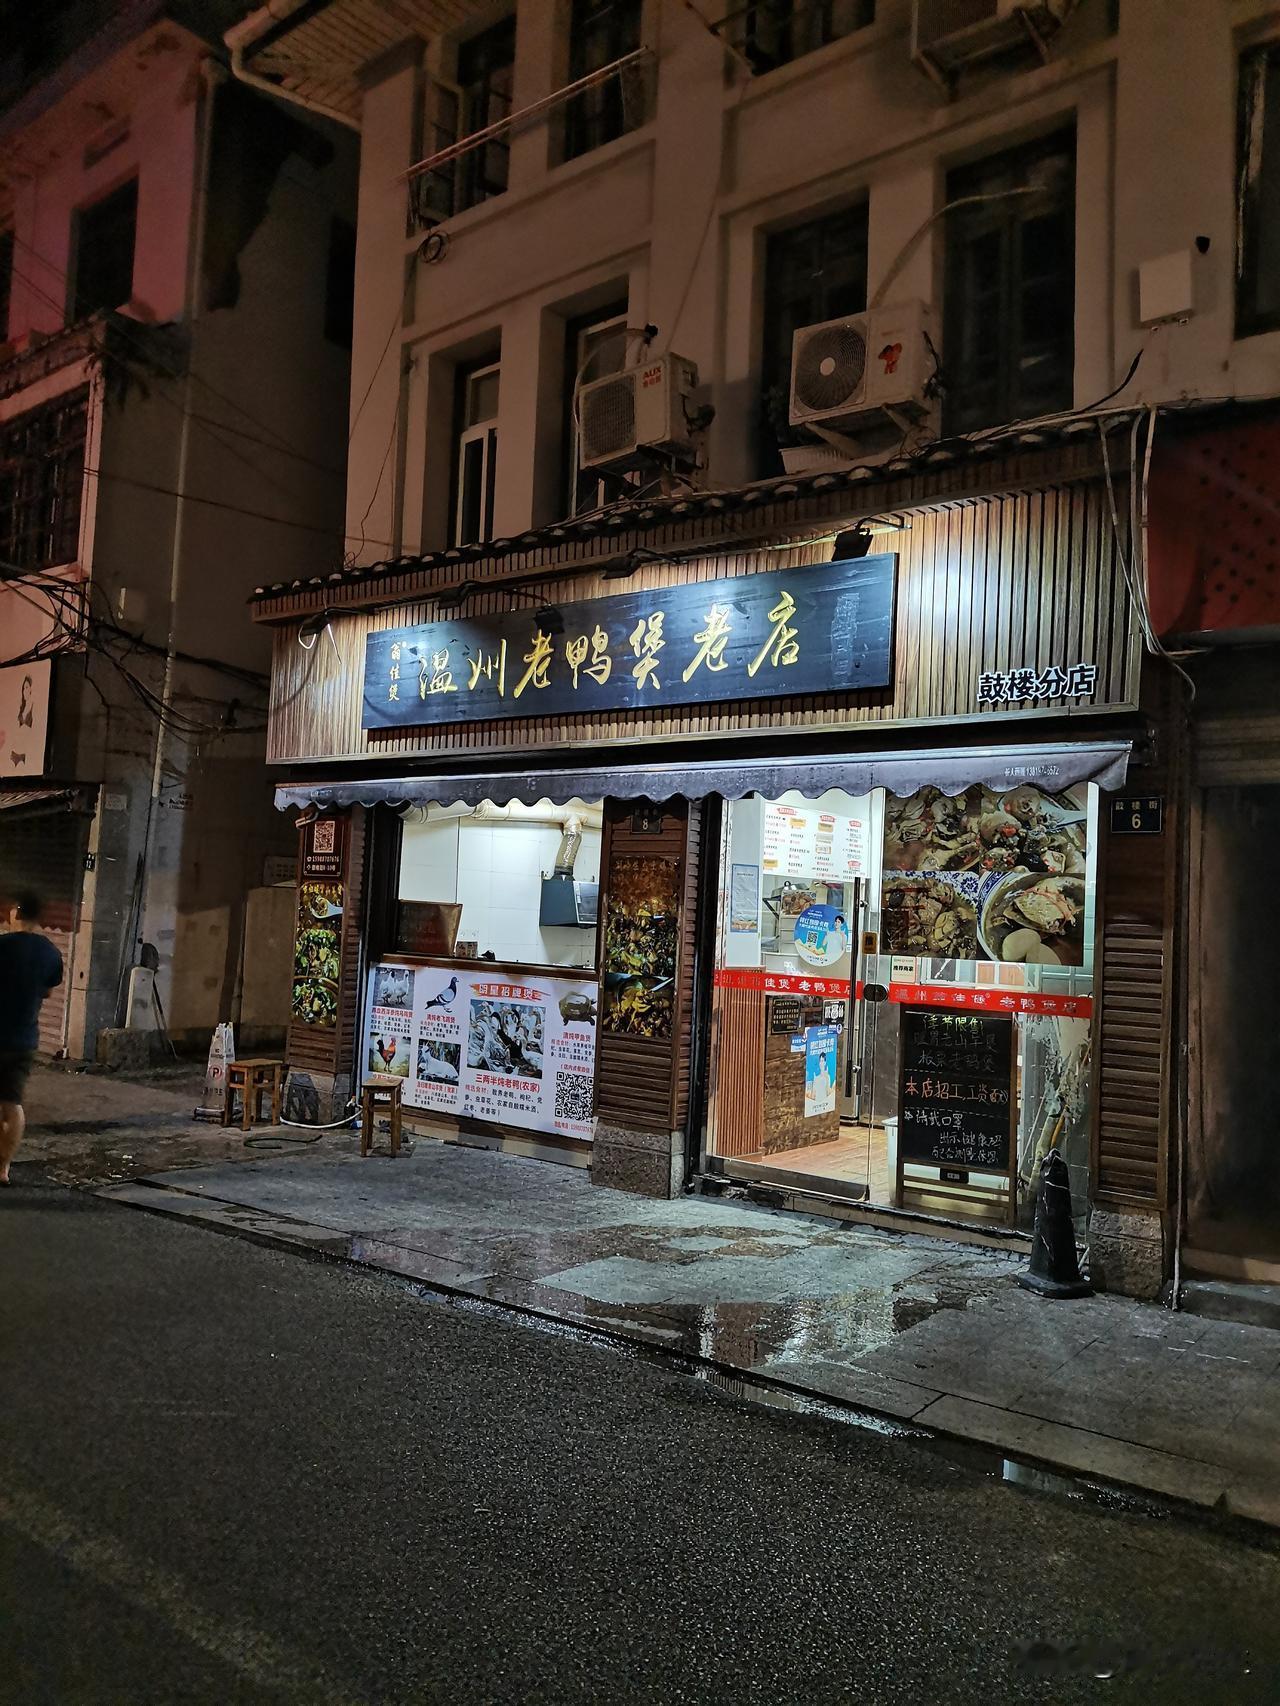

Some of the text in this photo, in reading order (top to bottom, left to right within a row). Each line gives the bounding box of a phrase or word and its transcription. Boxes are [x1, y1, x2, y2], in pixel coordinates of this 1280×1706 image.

[643, 366, 662, 378] AUX
[977, 663, 1097, 703] 鼓楼分店
[642, 818, 649, 830] 8
[1131, 813, 1141, 829] 6
[479, 984, 533, 999] 明星招牌煲
